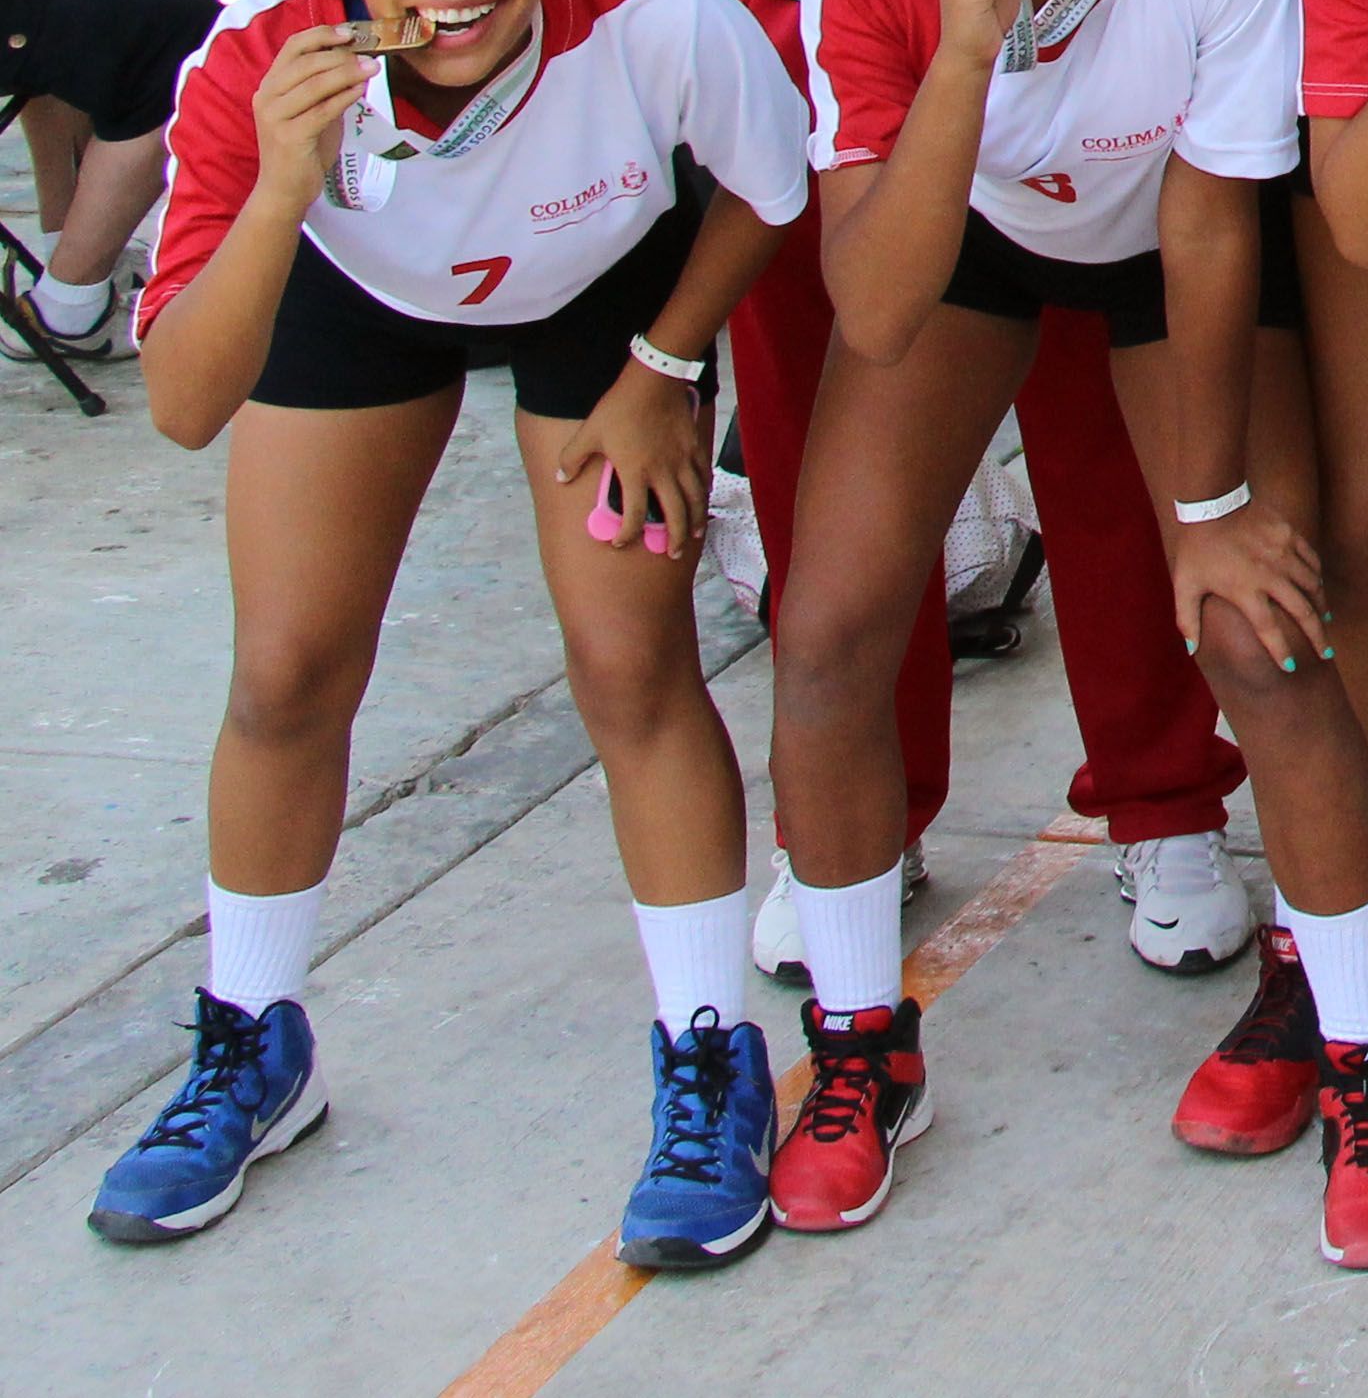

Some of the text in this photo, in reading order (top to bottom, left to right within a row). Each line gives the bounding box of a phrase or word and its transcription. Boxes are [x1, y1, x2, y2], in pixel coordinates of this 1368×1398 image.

[471, 105, 508, 146] JUEGOS
[1081, 125, 1167, 150] COLIMA
[344, 153, 360, 202] JUEGOS
[530, 179, 607, 218] COLIMA
[452, 256, 513, 306] 7
[823, 1014, 854, 1031] NIKE
